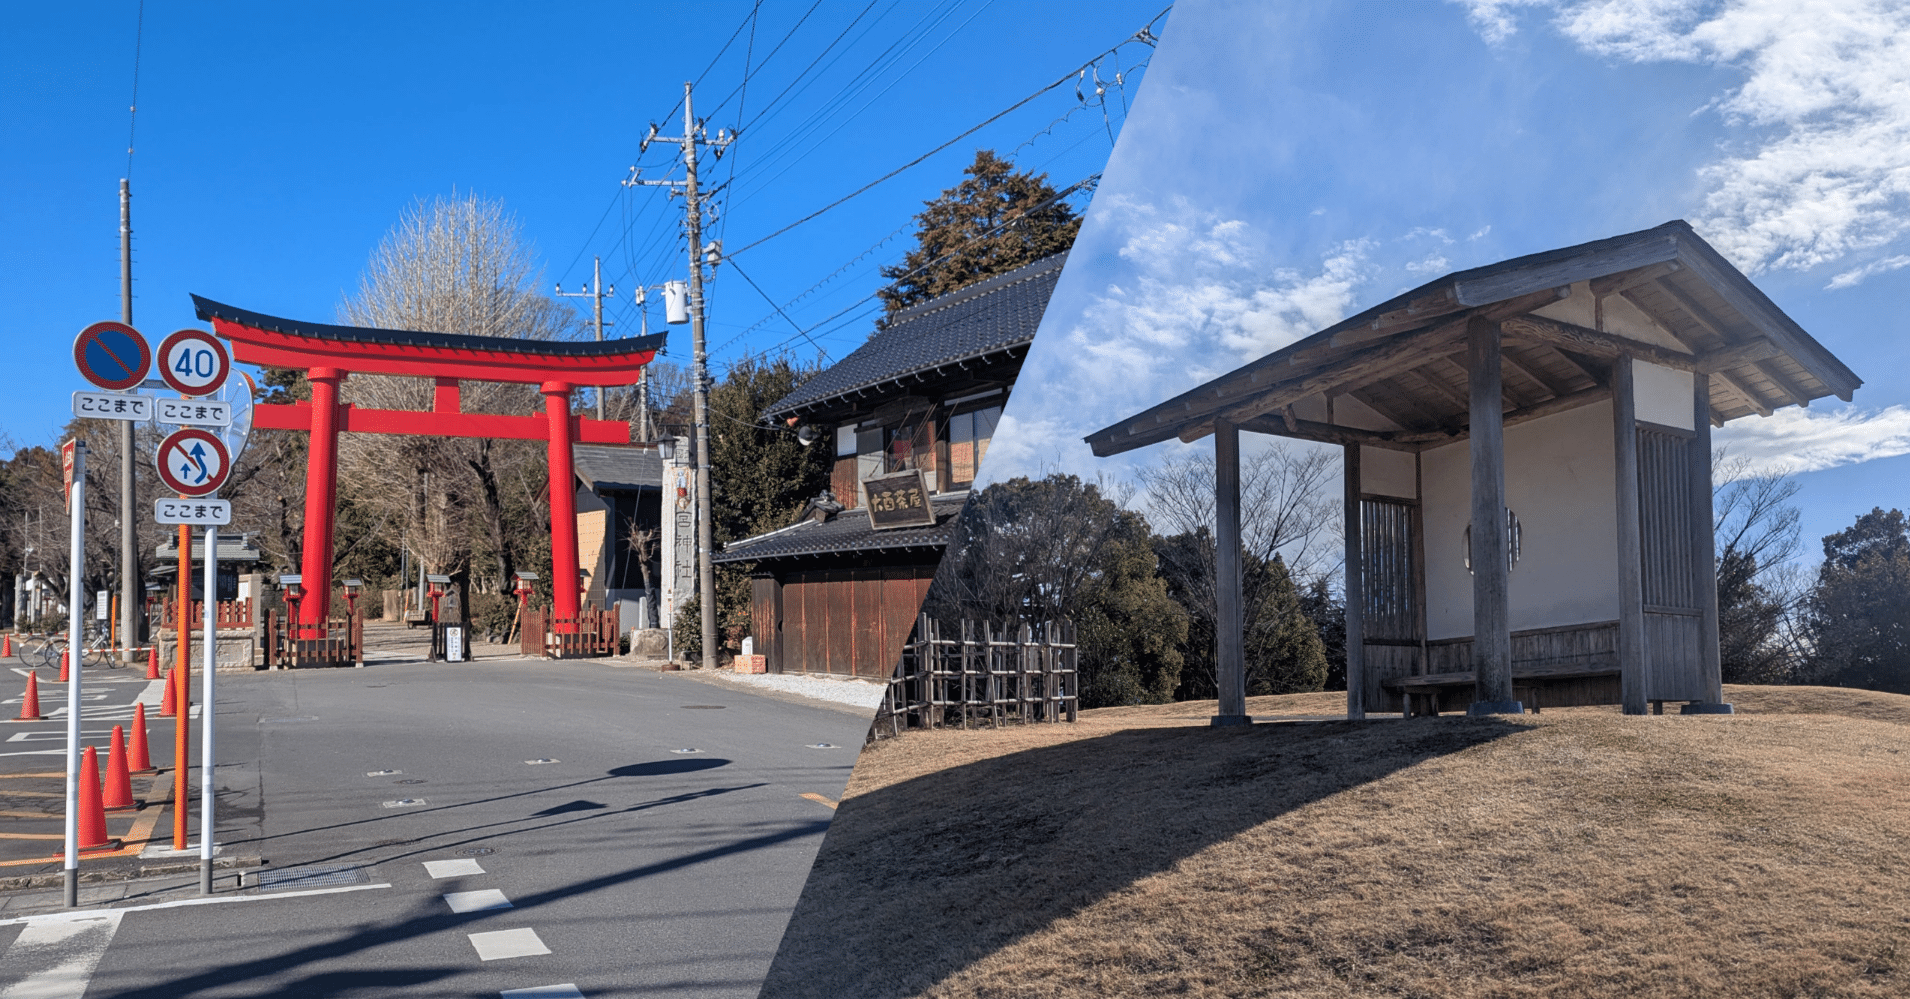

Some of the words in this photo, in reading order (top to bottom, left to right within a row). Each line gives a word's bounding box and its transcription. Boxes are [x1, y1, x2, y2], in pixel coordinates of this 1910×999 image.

[175, 348, 214, 378] 40
[81, 397, 145, 415] ここまで
[163, 404, 224, 421] ここまで
[163, 504, 223, 519] ここまで
